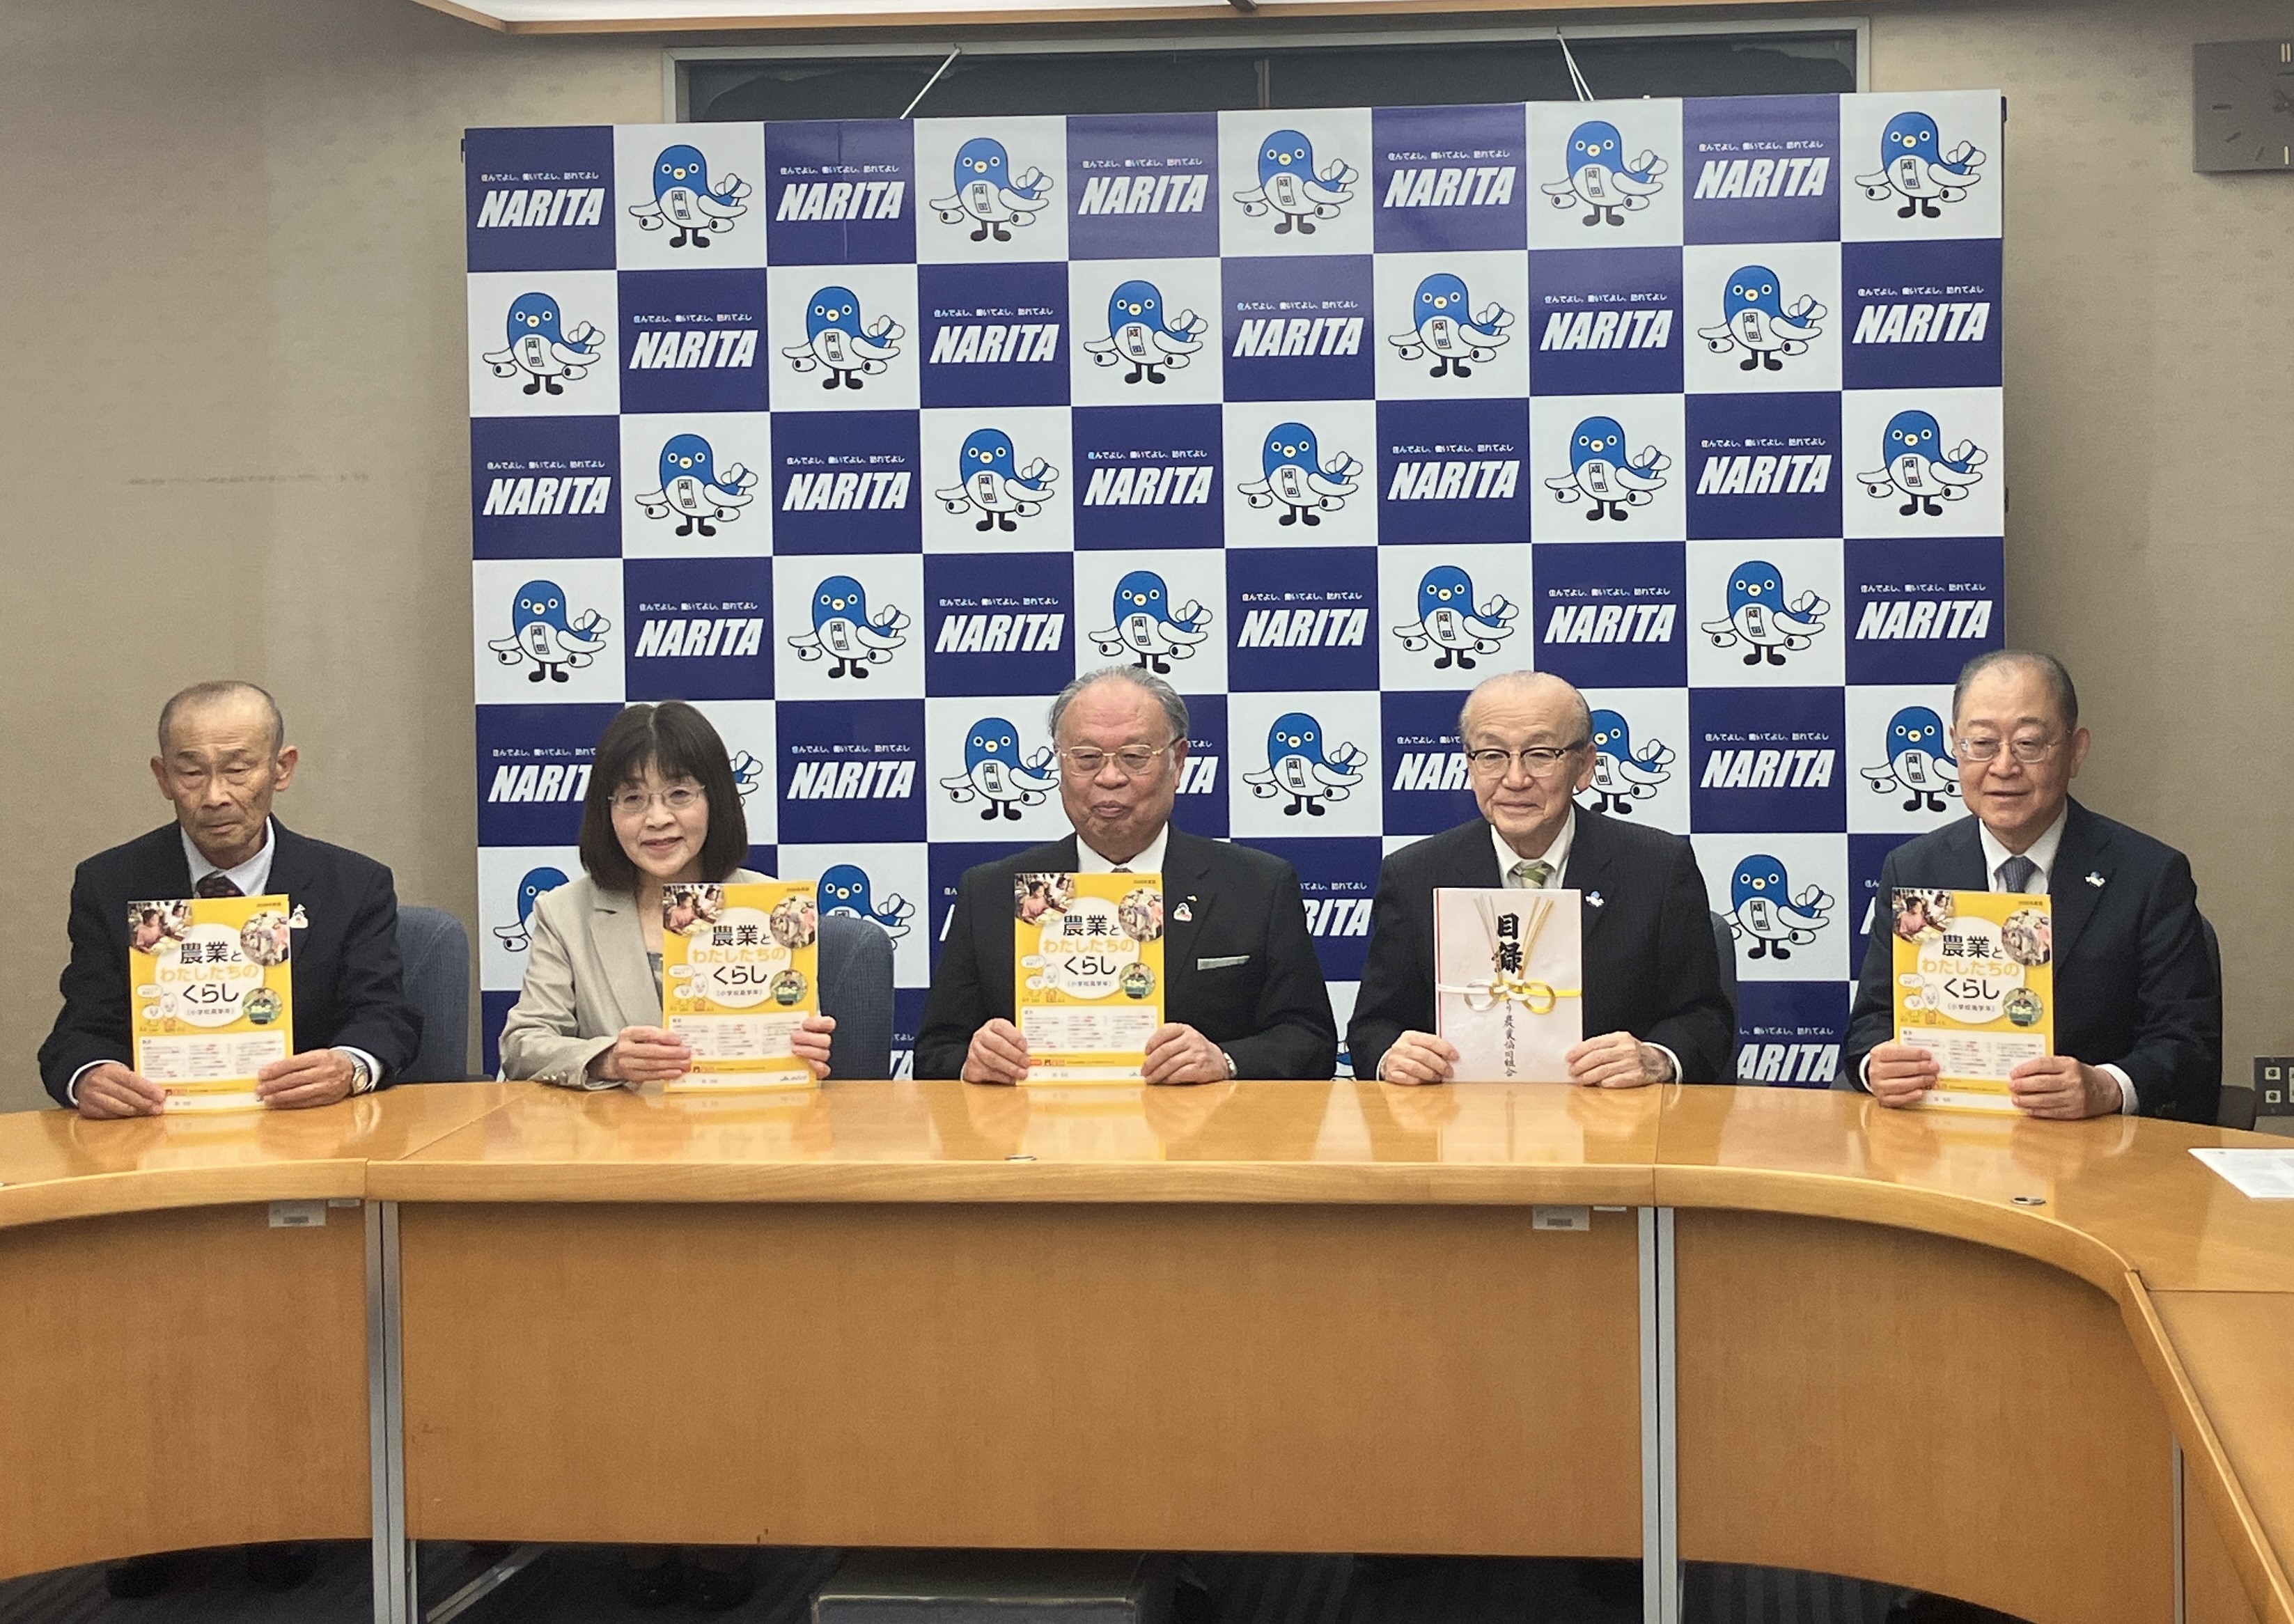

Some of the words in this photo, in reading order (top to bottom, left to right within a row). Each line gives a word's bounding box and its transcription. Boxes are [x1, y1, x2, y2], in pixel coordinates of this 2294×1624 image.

[1078, 175, 1208, 214] NARITA
[1383, 167, 1515, 207] NARITA
[1694, 157, 1829, 198] NARITA
[477, 189, 604, 227] NARITA
[777, 182, 905, 221] NARITA
[1233, 318, 1364, 357] NARITA
[1540, 310, 1673, 350] NARITA
[1852, 303, 1990, 343] NARITA
[630, 330, 758, 368] NARITA
[930, 325, 1059, 363] NARITA
[782, 472, 911, 510] NARITA
[1083, 467, 1213, 505] NARITA
[1388, 461, 1520, 499] NARITA
[1696, 455, 1832, 494] NARITA
[483, 477, 611, 515] NARITA
[635, 618, 763, 657] NARITA
[935, 614, 1064, 652] NARITA
[1238, 609, 1368, 647] NARITA
[1543, 604, 1676, 643] NARITA
[1855, 600, 1992, 639] NARITA
[788, 761, 916, 799] NARITA
[1393, 753, 1471, 790] NAR
[1701, 750, 1835, 788] NARITA
[712, 924, 771, 946] 農業と
[1063, 914, 1121, 937] 農業と
[1492, 912, 1523, 974] 目録
[180, 941, 242, 965] 農業と
[692, 947, 786, 963] わたしたちの
[1043, 938, 1134, 954] わたしたちの
[1942, 934, 2003, 959] 農業と
[160, 964, 258, 983] わたしたちの
[713, 965, 767, 985] くらし
[1063, 955, 1116, 976] くらし
[1922, 958, 2020, 977] わたしたちの
[182, 983, 240, 1004] くらし
[1944, 977, 2000, 1001] くらし
